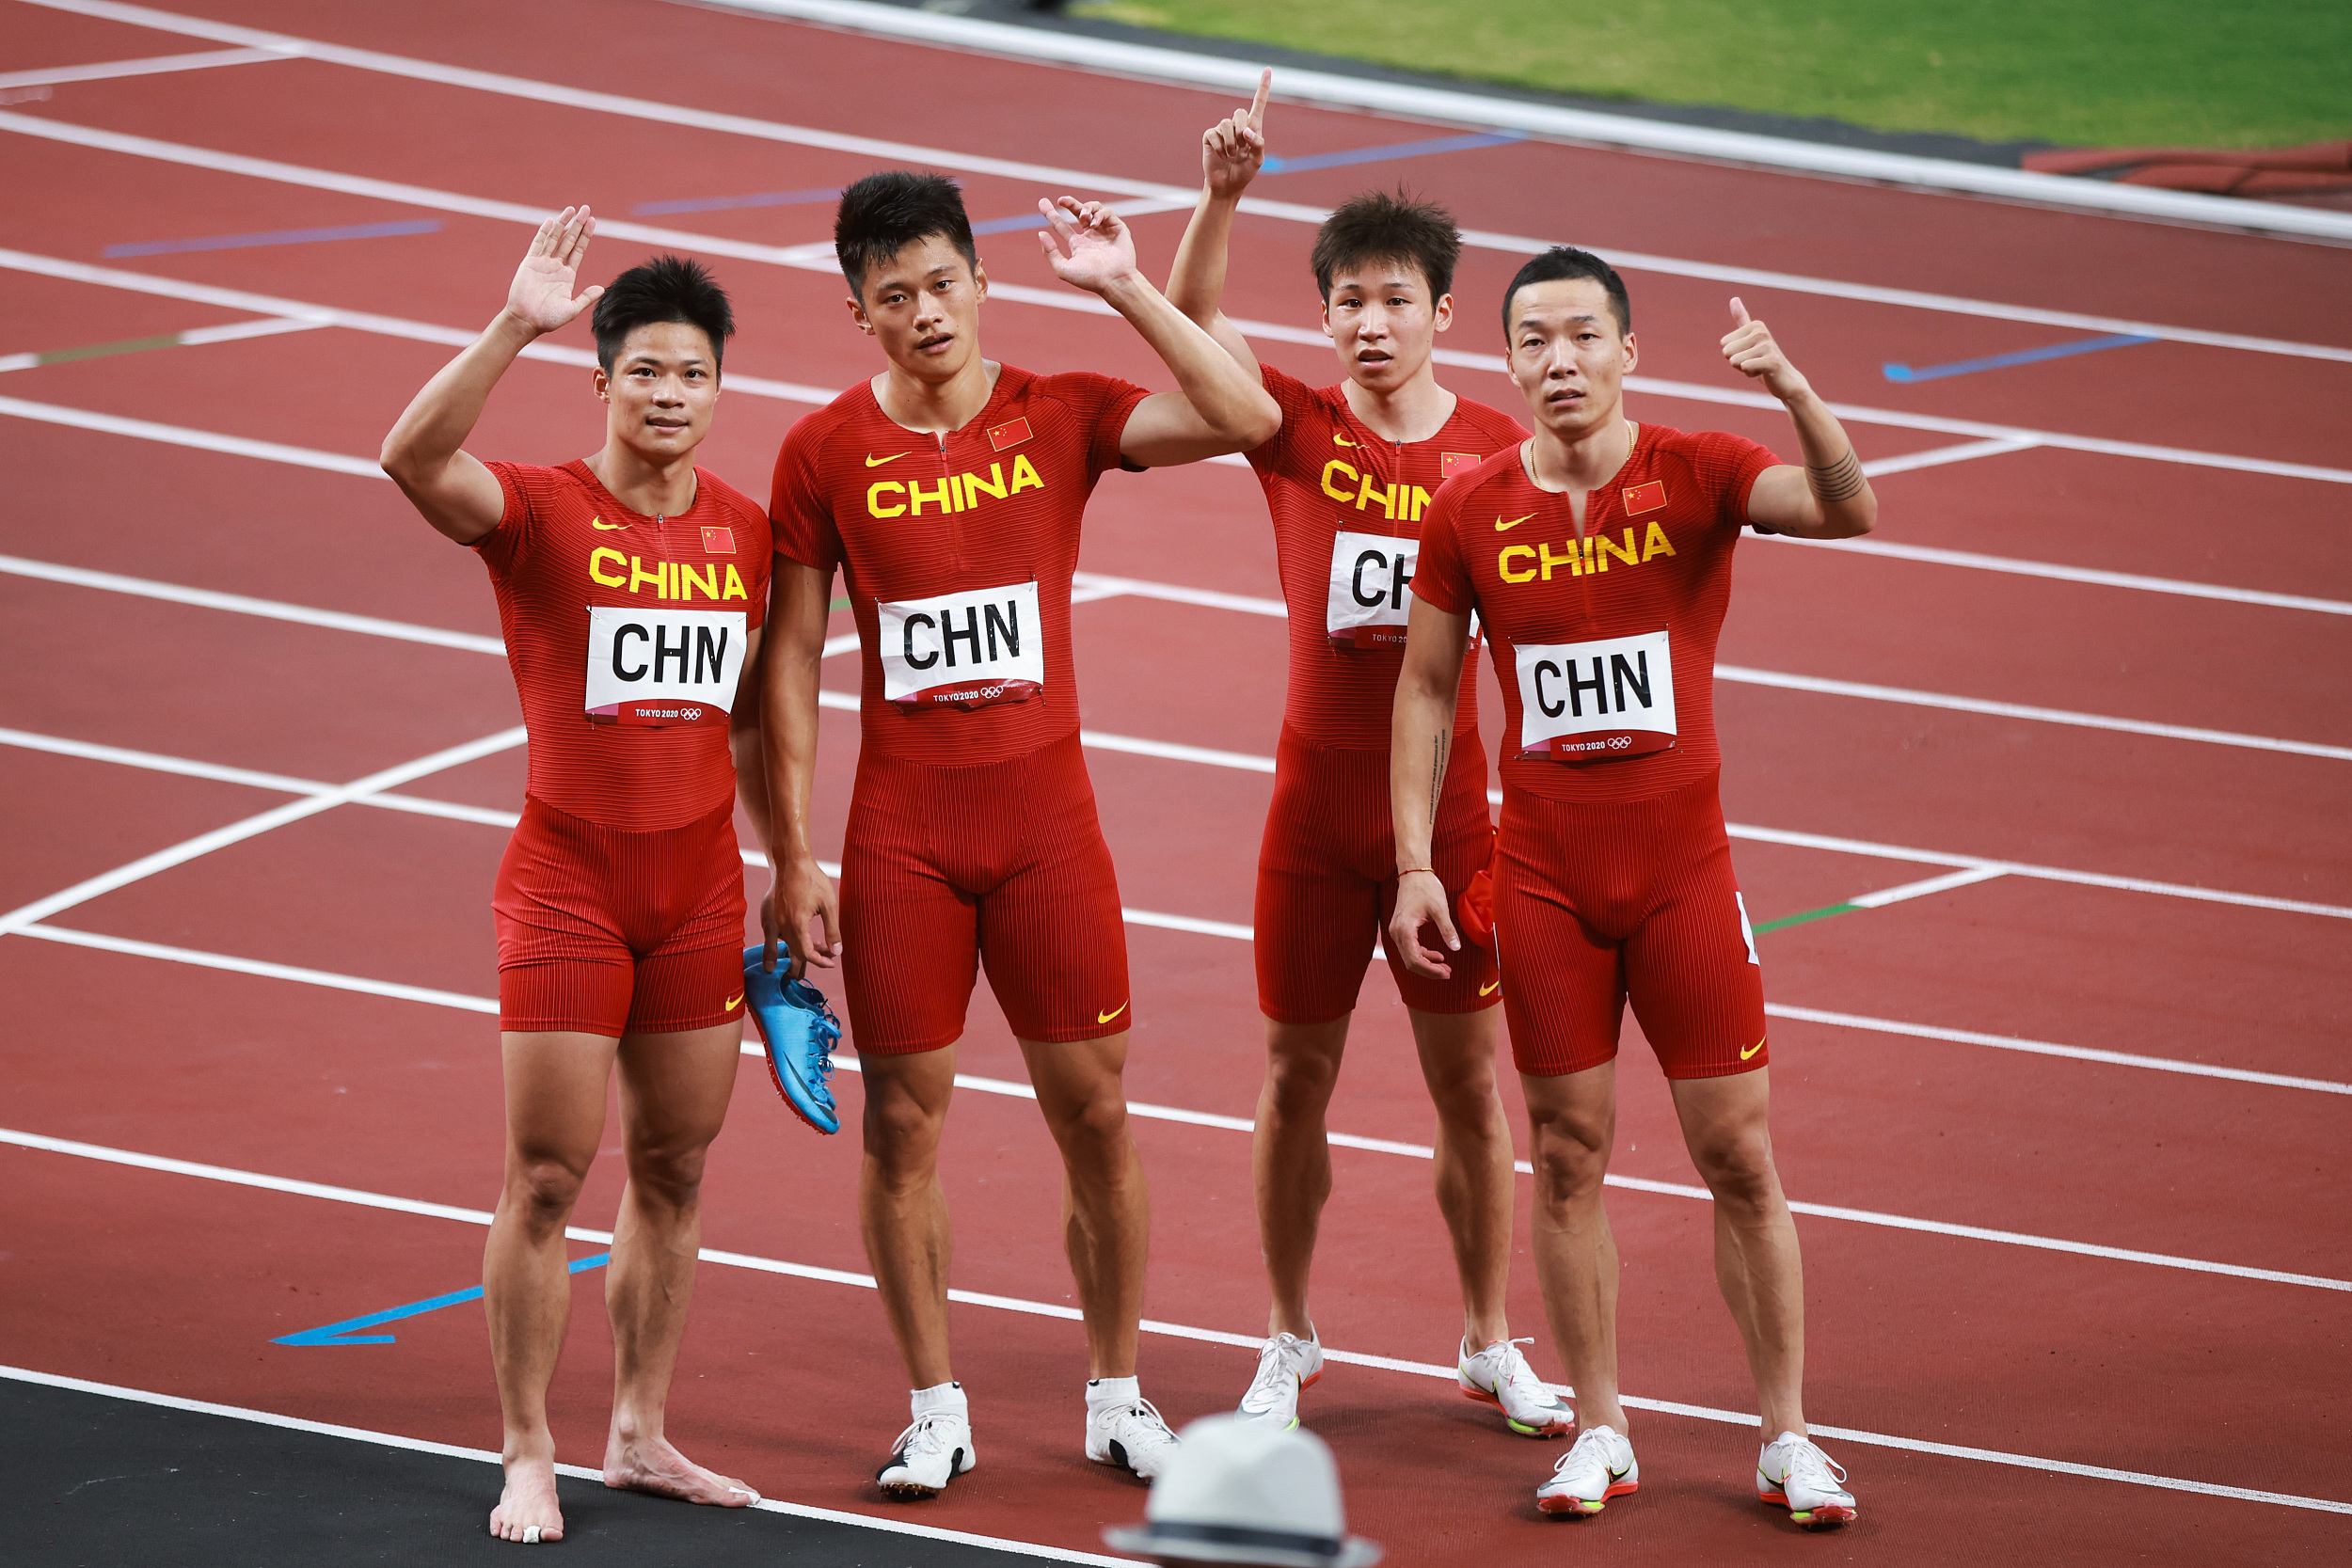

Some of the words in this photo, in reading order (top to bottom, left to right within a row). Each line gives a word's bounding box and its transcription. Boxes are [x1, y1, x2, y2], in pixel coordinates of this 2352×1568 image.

[866, 453, 1045, 519] CHINA
[1320, 459, 1433, 522] CHIN
[589, 546, 749, 601] CHINA
[1351, 549, 1416, 610] CH
[1498, 520, 1677, 584] CHINA
[612, 623, 728, 685] CHN
[903, 599, 1021, 671] CHN
[1372, 633, 1397, 642] TOKYO
[635, 708, 660, 718] TOKYO
[661, 709, 678, 718] 2020
[933, 691, 959, 703] TOKYO
[959, 690, 979, 701] 2020
[1534, 650, 1653, 719] CHN
[1561, 743, 1585, 752] TOKYO
[1586, 740, 1606, 751] 2020
